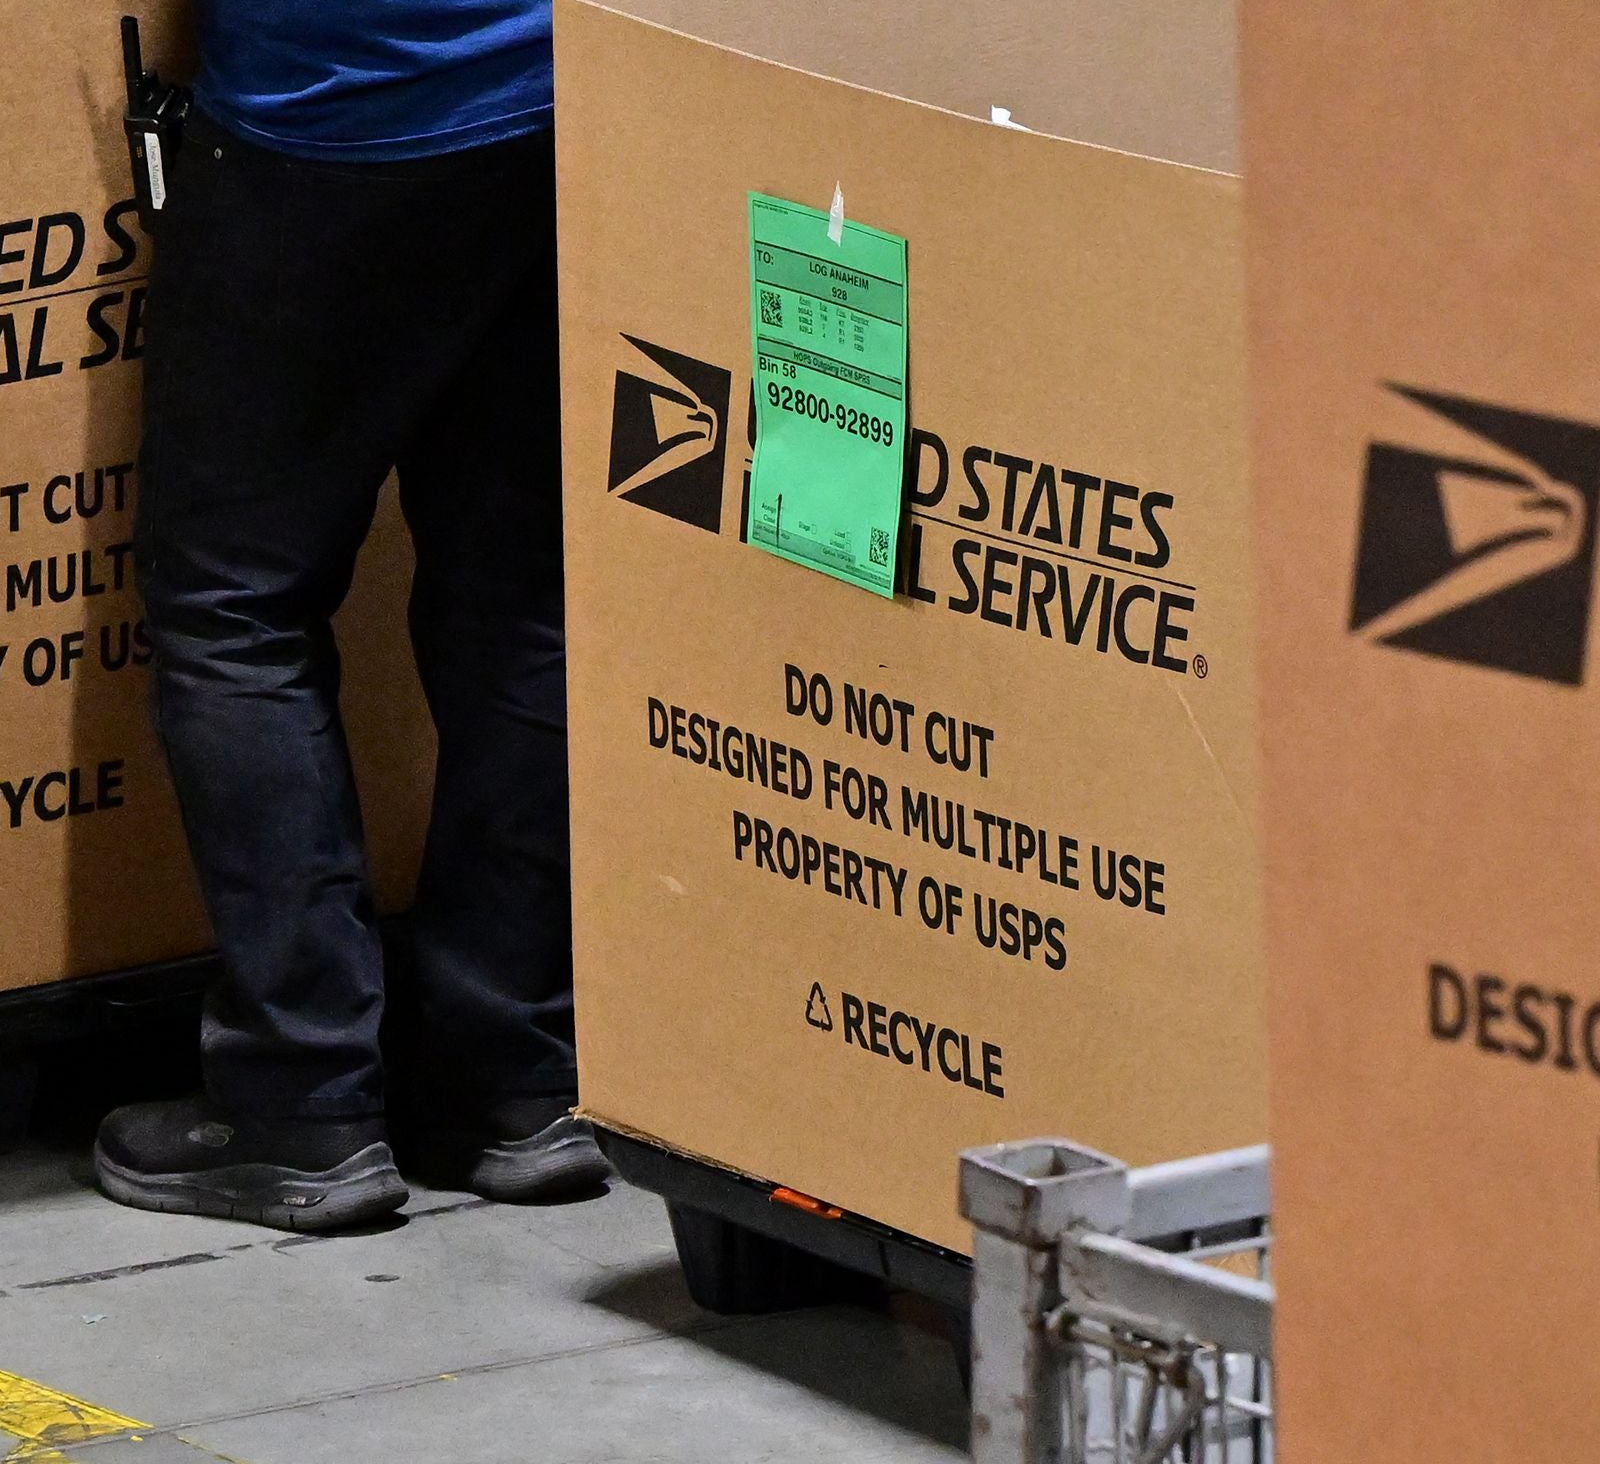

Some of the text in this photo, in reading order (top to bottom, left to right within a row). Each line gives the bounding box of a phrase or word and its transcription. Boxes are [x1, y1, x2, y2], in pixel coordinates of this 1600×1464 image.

[756, 249, 774, 265] TO:
[809, 261, 869, 290] LOG ANAHEIM
[831, 286, 848, 301] 928
[759, 356, 797, 379] Bin 58
[767, 381, 894, 447] 92800-92899
[43, 463, 135, 524] CUT
[958, 445, 1174, 570] STATES
[6, 542, 135, 613] MULT
[22, 631, 85, 689] OF
[101, 620, 152, 672] US
[784, 662, 994, 779] DO NOT CUT
[647, 695, 1167, 916] DESIGNED FOR MULTIPLE USE
[733, 809, 1068, 971] PROPERTY OF USPS
[841, 991, 1005, 1100] RECYCLE
